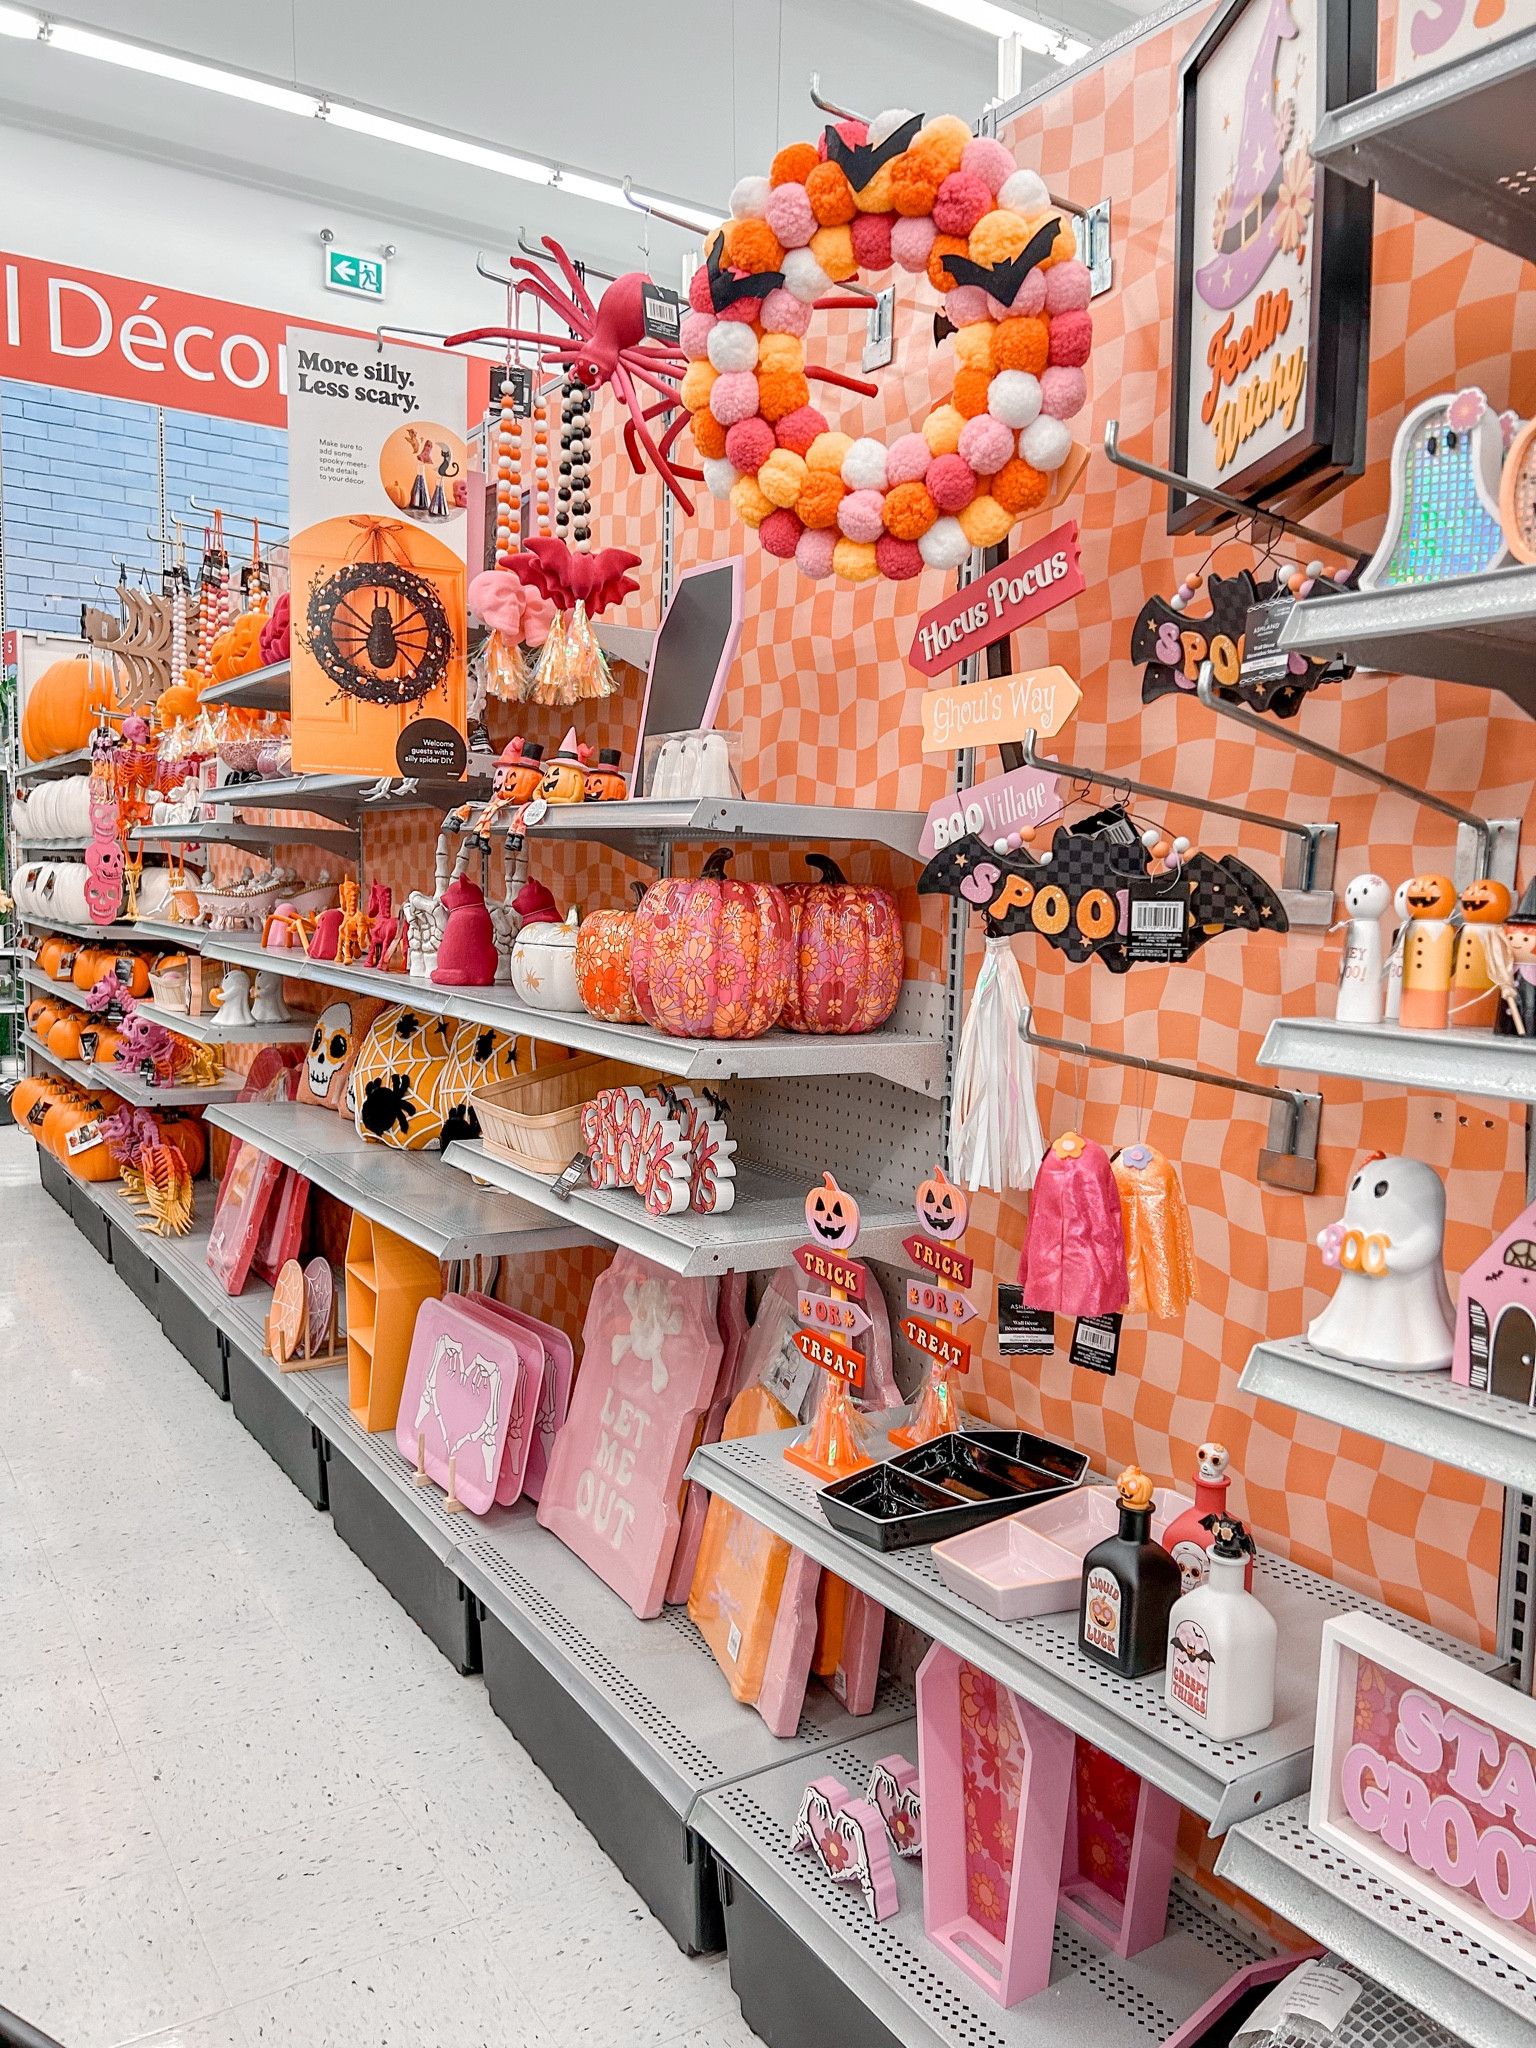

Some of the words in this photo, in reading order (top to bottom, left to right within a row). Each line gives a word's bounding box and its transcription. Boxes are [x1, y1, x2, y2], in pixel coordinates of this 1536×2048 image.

[297, 349, 359, 377] More
[364, 361, 415, 390] silly.
[1201, 287, 1293, 425] Feelin
[298, 372, 349, 399] Less
[355, 386, 420, 414] scary.
[1212, 345, 1307, 471] Witchy
[319, 438, 339, 447] Make
[319, 447, 333, 455] add
[319, 457, 370, 469] spooky-meets-
[319, 465, 335, 473] cute
[335, 466, 358, 476] details
[328, 475, 344, 483] your
[344, 476, 366, 486] décor.
[918, 601, 989, 662] Hocus
[987, 551, 1069, 618] Pocus
[1253, 622, 1281, 635] ASHLAND
[932, 686, 1003, 744] Ghoul's
[1008, 676, 1057, 729] Way
[404, 754, 418, 764] silly
[419, 755, 440, 764] spider
[440, 757, 454, 765] DIY.
[422, 738, 454, 748] Welcome
[433, 748, 449, 756] with
[931, 802, 985, 850] BOO
[983, 781, 1046, 830] Village
[1344, 965, 1368, 982] OO!
[581, 1087, 676, 1170] GROOVY
[804, 1252, 857, 1292] TRICK
[913, 1241, 964, 1282] TRICK
[815, 1301, 842, 1326] OR
[923, 1289, 949, 1314] OR
[800, 1335, 857, 1380] TREAT
[907, 1321, 962, 1366] TREAT
[601, 1387, 651, 1449] LET
[596, 1429, 636, 1486] ME
[577, 1468, 635, 1549] OUT
[1089, 1576, 1121, 1601] LIQUID
[1086, 1624, 1116, 1654] LUCK
[1172, 1666, 1207, 1698] CREEPY
[1173, 1681, 1206, 1715] THINGS
[1341, 1742, 1536, 1920] GROO
